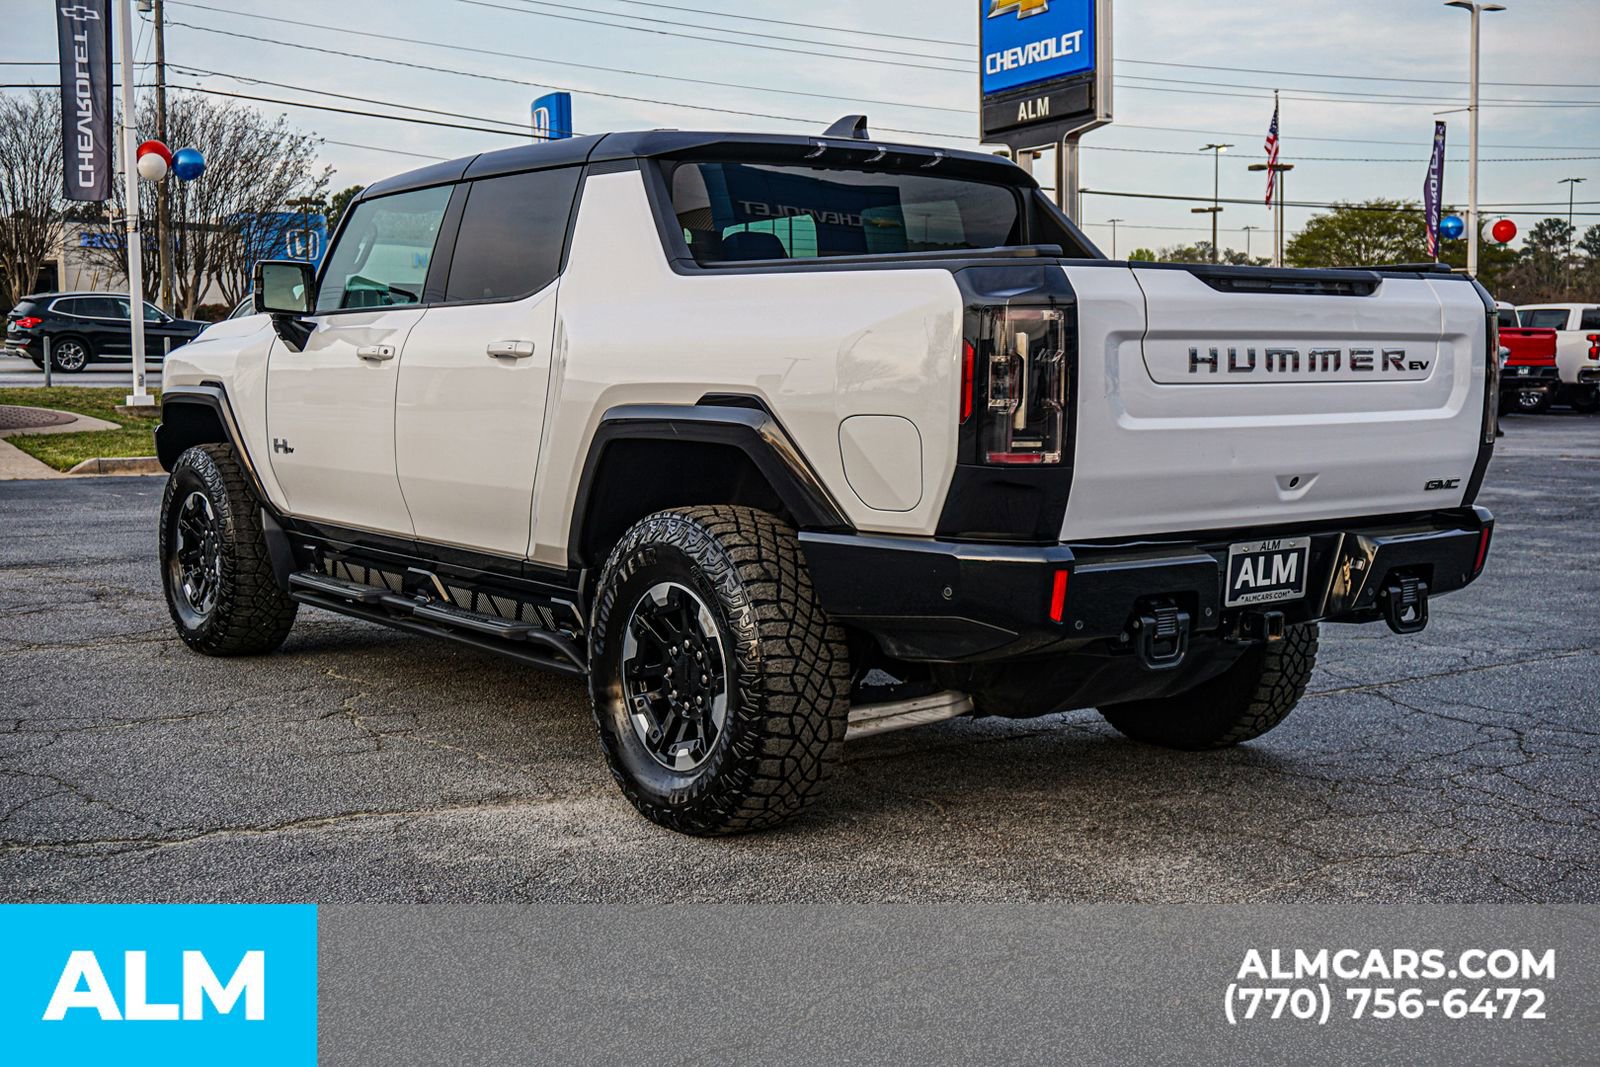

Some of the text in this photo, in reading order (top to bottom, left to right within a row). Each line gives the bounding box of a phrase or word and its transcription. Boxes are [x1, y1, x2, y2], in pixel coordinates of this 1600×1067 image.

[985, 29, 1083, 75] CHEVROLET
[1017, 96, 1050, 121] ALM
[1189, 347, 1430, 373] HUMMER EV
[1424, 478, 1461, 491] GMC
[1260, 539, 1281, 552] ALM
[1234, 552, 1299, 590] ALM
